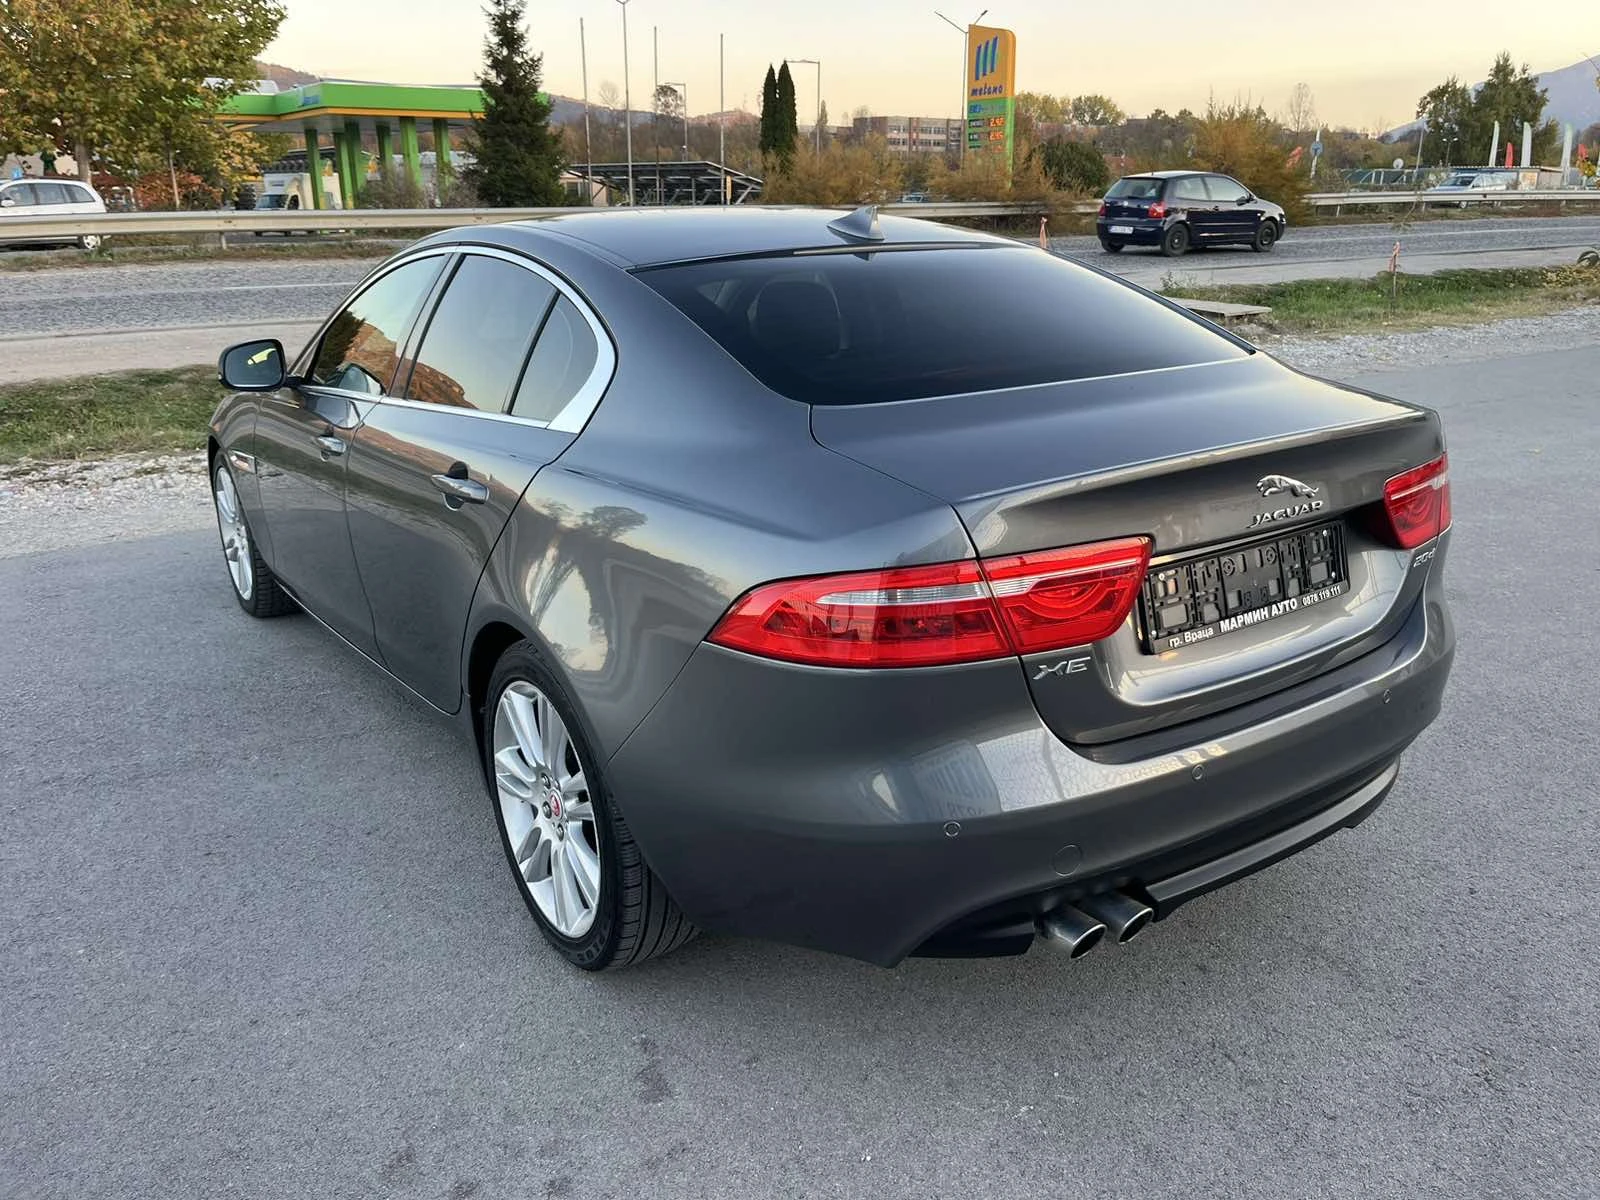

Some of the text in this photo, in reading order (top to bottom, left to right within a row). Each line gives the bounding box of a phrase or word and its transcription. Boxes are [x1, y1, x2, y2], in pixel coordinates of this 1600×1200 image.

[1247, 500, 1323, 528] JAGUAR
[1413, 547, 1436, 568] 20d
[1169, 637, 1183, 648] гр.
[1184, 626, 1214, 643] Враца
[1220, 609, 1269, 633] МАРМИН
[1271, 598, 1298, 617] АУТО
[1330, 585, 1341, 596] 111
[1032, 656, 1092, 680] XE
